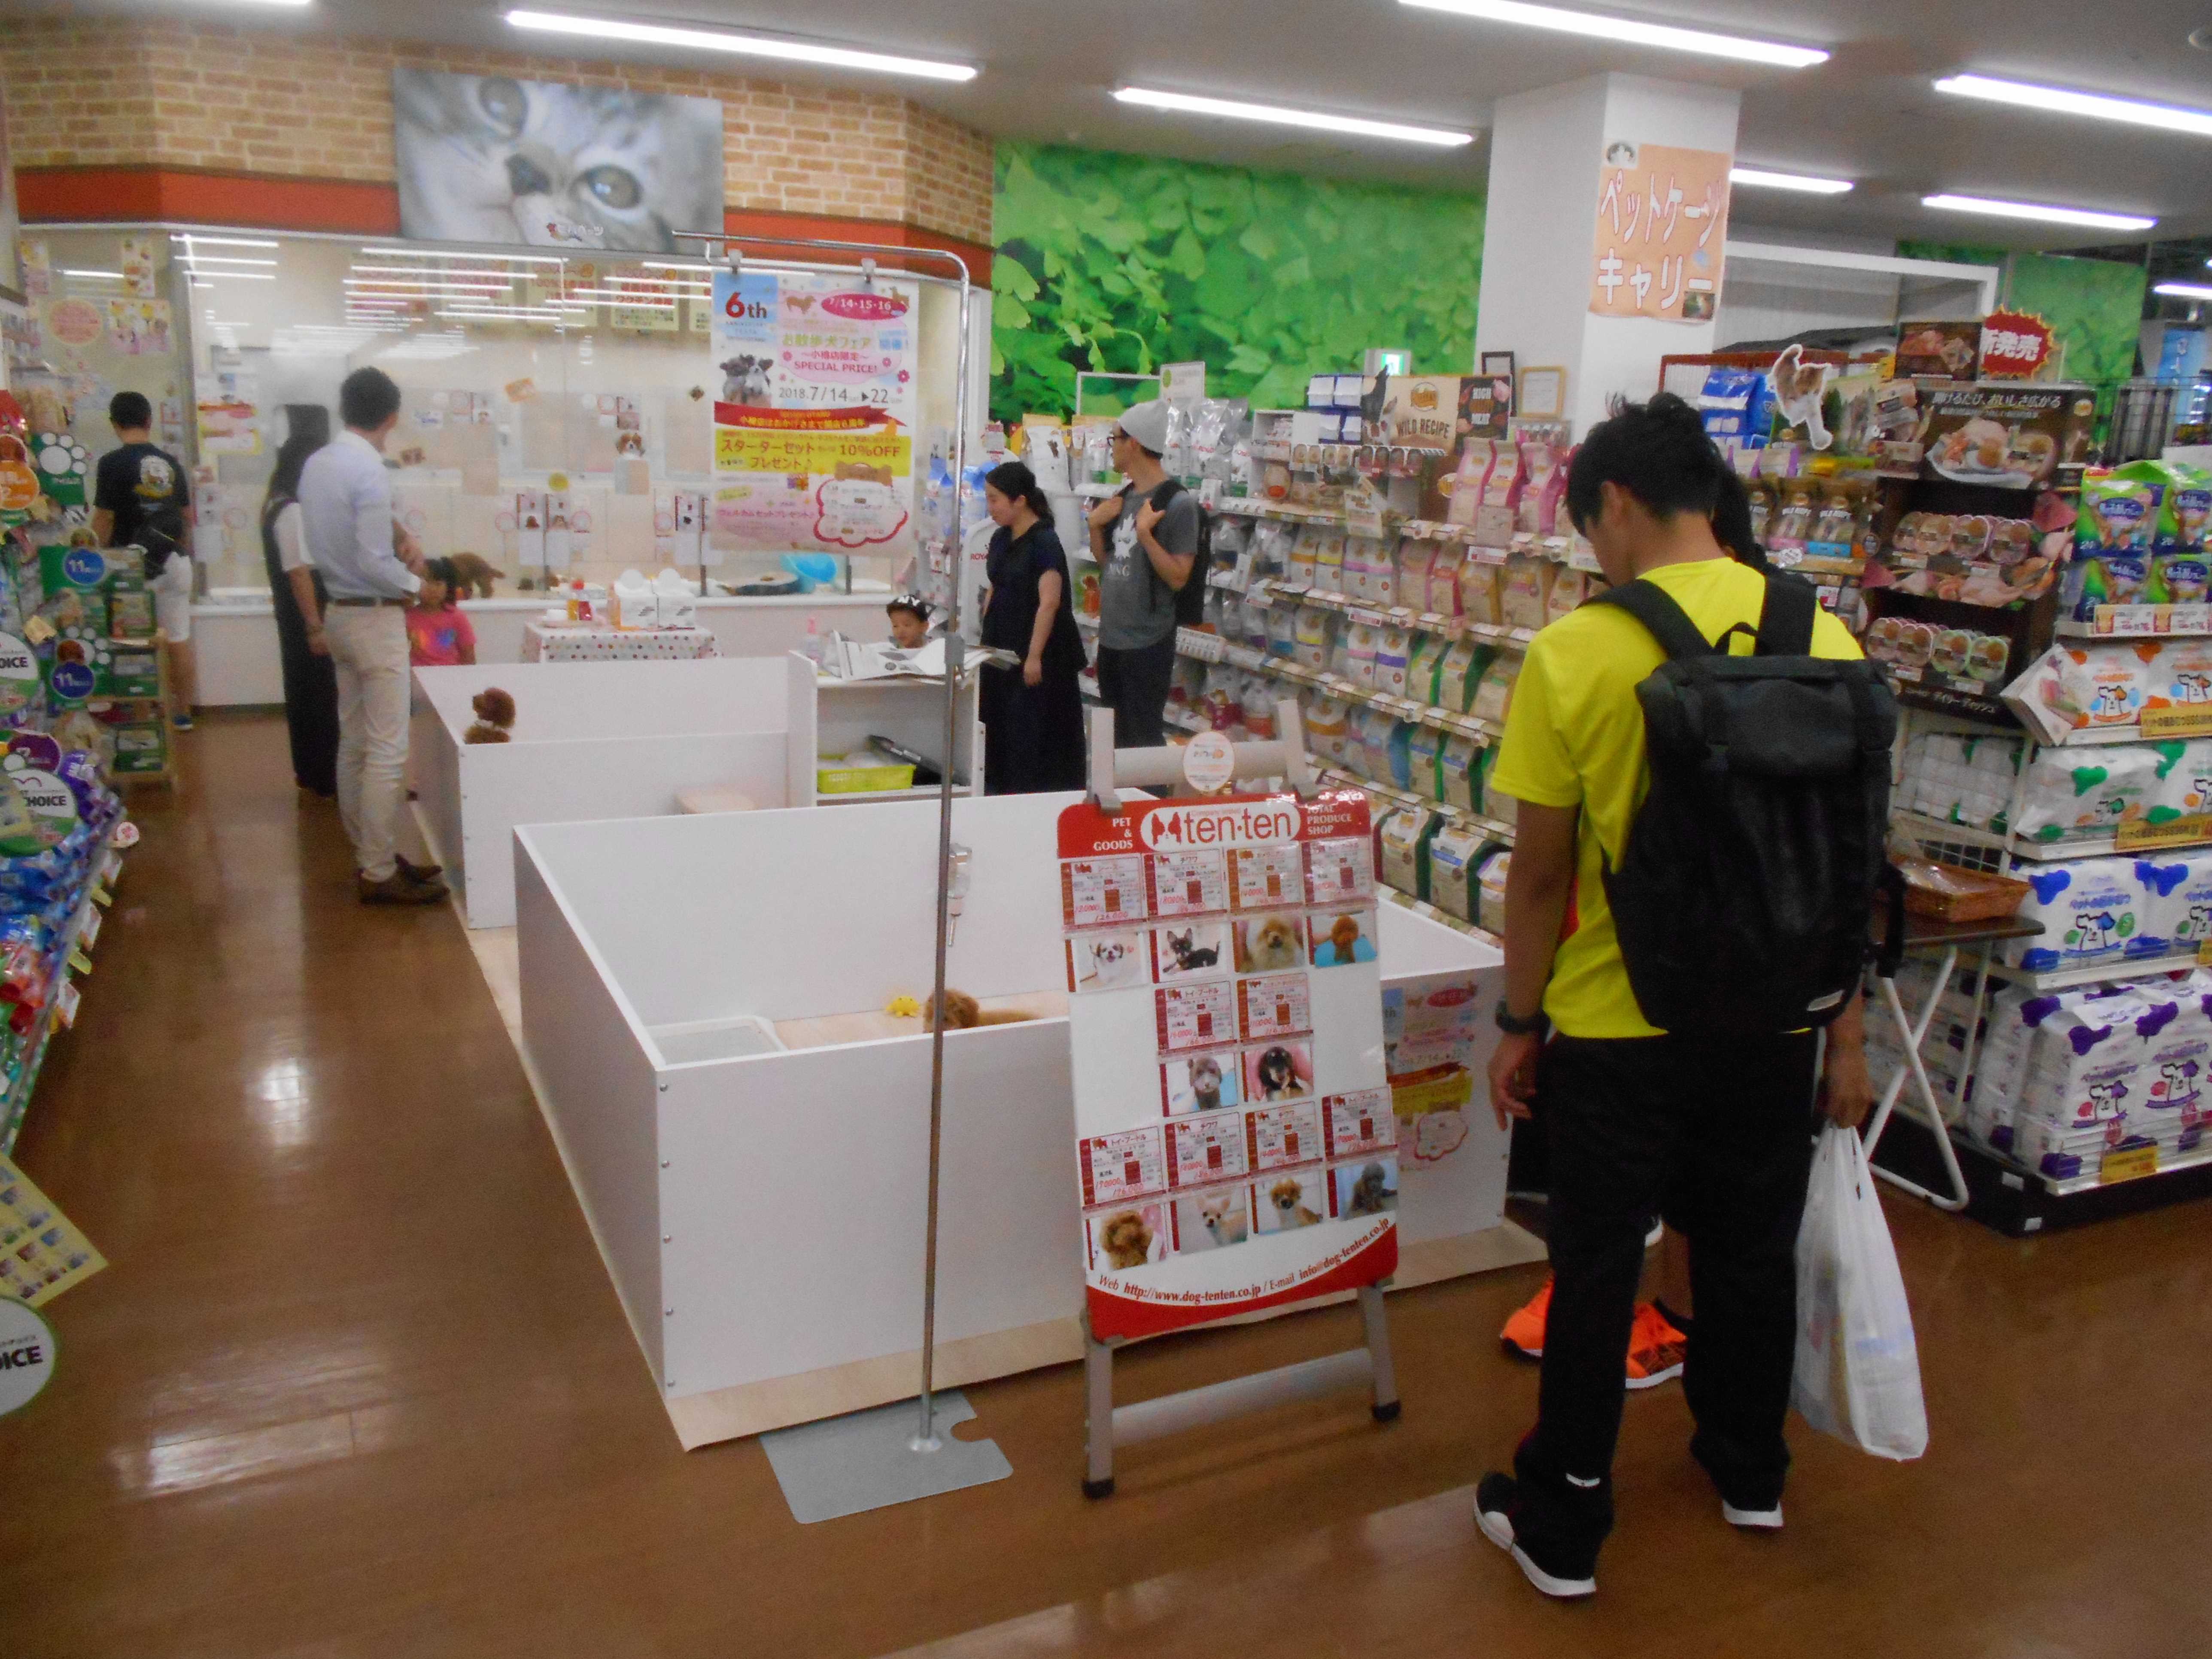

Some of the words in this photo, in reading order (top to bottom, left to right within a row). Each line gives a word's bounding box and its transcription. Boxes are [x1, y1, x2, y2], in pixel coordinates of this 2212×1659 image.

[1597, 247, 1713, 310] キャリー
[726, 292, 767, 319] 6th
[795, 362, 839, 371] SPECIAL
[843, 363, 877, 373] PRICE!
[871, 389, 888, 403] 22
[1396, 419, 1417, 437] WILD
[1420, 418, 1450, 439] RECIPE
[721, 439, 814, 454] スターターセット
[840, 445, 900, 457] 10%OFF
[24, 795, 67, 806] HOICE
[1112, 817, 1131, 827] PET
[1307, 814, 1352, 825] PRODUCE
[1124, 830, 1132, 838] &
[1307, 825, 1334, 835] SHOP
[1093, 839, 1133, 851] GOODS
[1100, 1274, 1119, 1290] Web
[1124, 1282, 1261, 1304] http://www.dog-tenten.co.jp
[1270, 1272, 1295, 1289] E-mail
[0, 1345, 43, 1370] ICE
